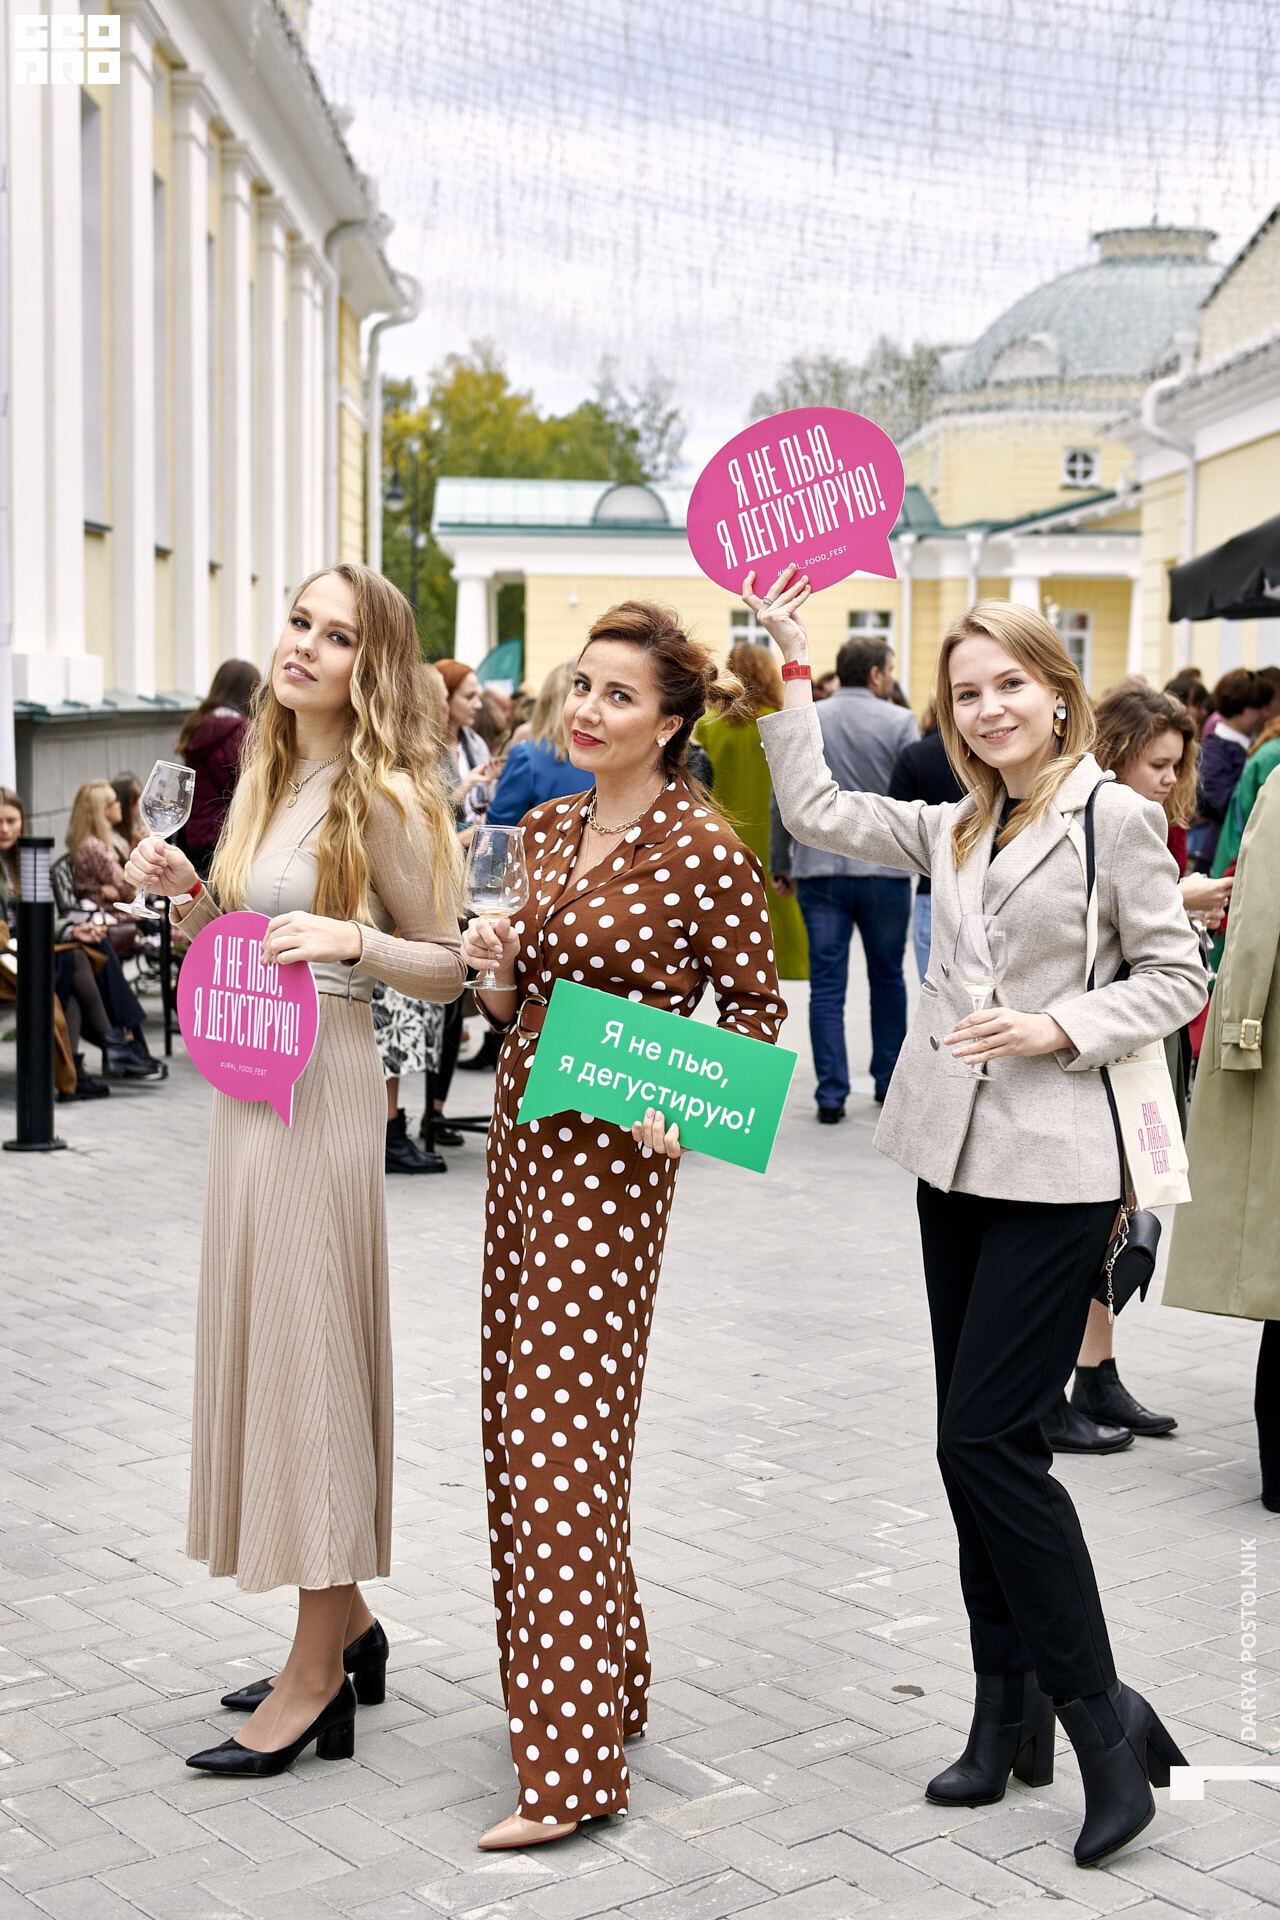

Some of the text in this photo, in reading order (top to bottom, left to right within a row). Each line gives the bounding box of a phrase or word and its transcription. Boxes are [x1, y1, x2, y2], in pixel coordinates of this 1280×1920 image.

[728, 424, 844, 509] Я НЕ ПЬЮ,
[716, 462, 886, 570] Я ДЕГУСТИРУЮ!
[777, 545, 847, 577] #L_FOOD_FEST
[213, 934, 223, 986] Я
[226, 936, 244, 989] НЕ
[193, 987, 300, 1056] Я ДЕГУСТИРУЮ!
[601, 1020, 728, 1088] Я не пью,
[558, 1055, 755, 1134] я дегустирую!
[1138, 1129, 1146, 1152] Я
